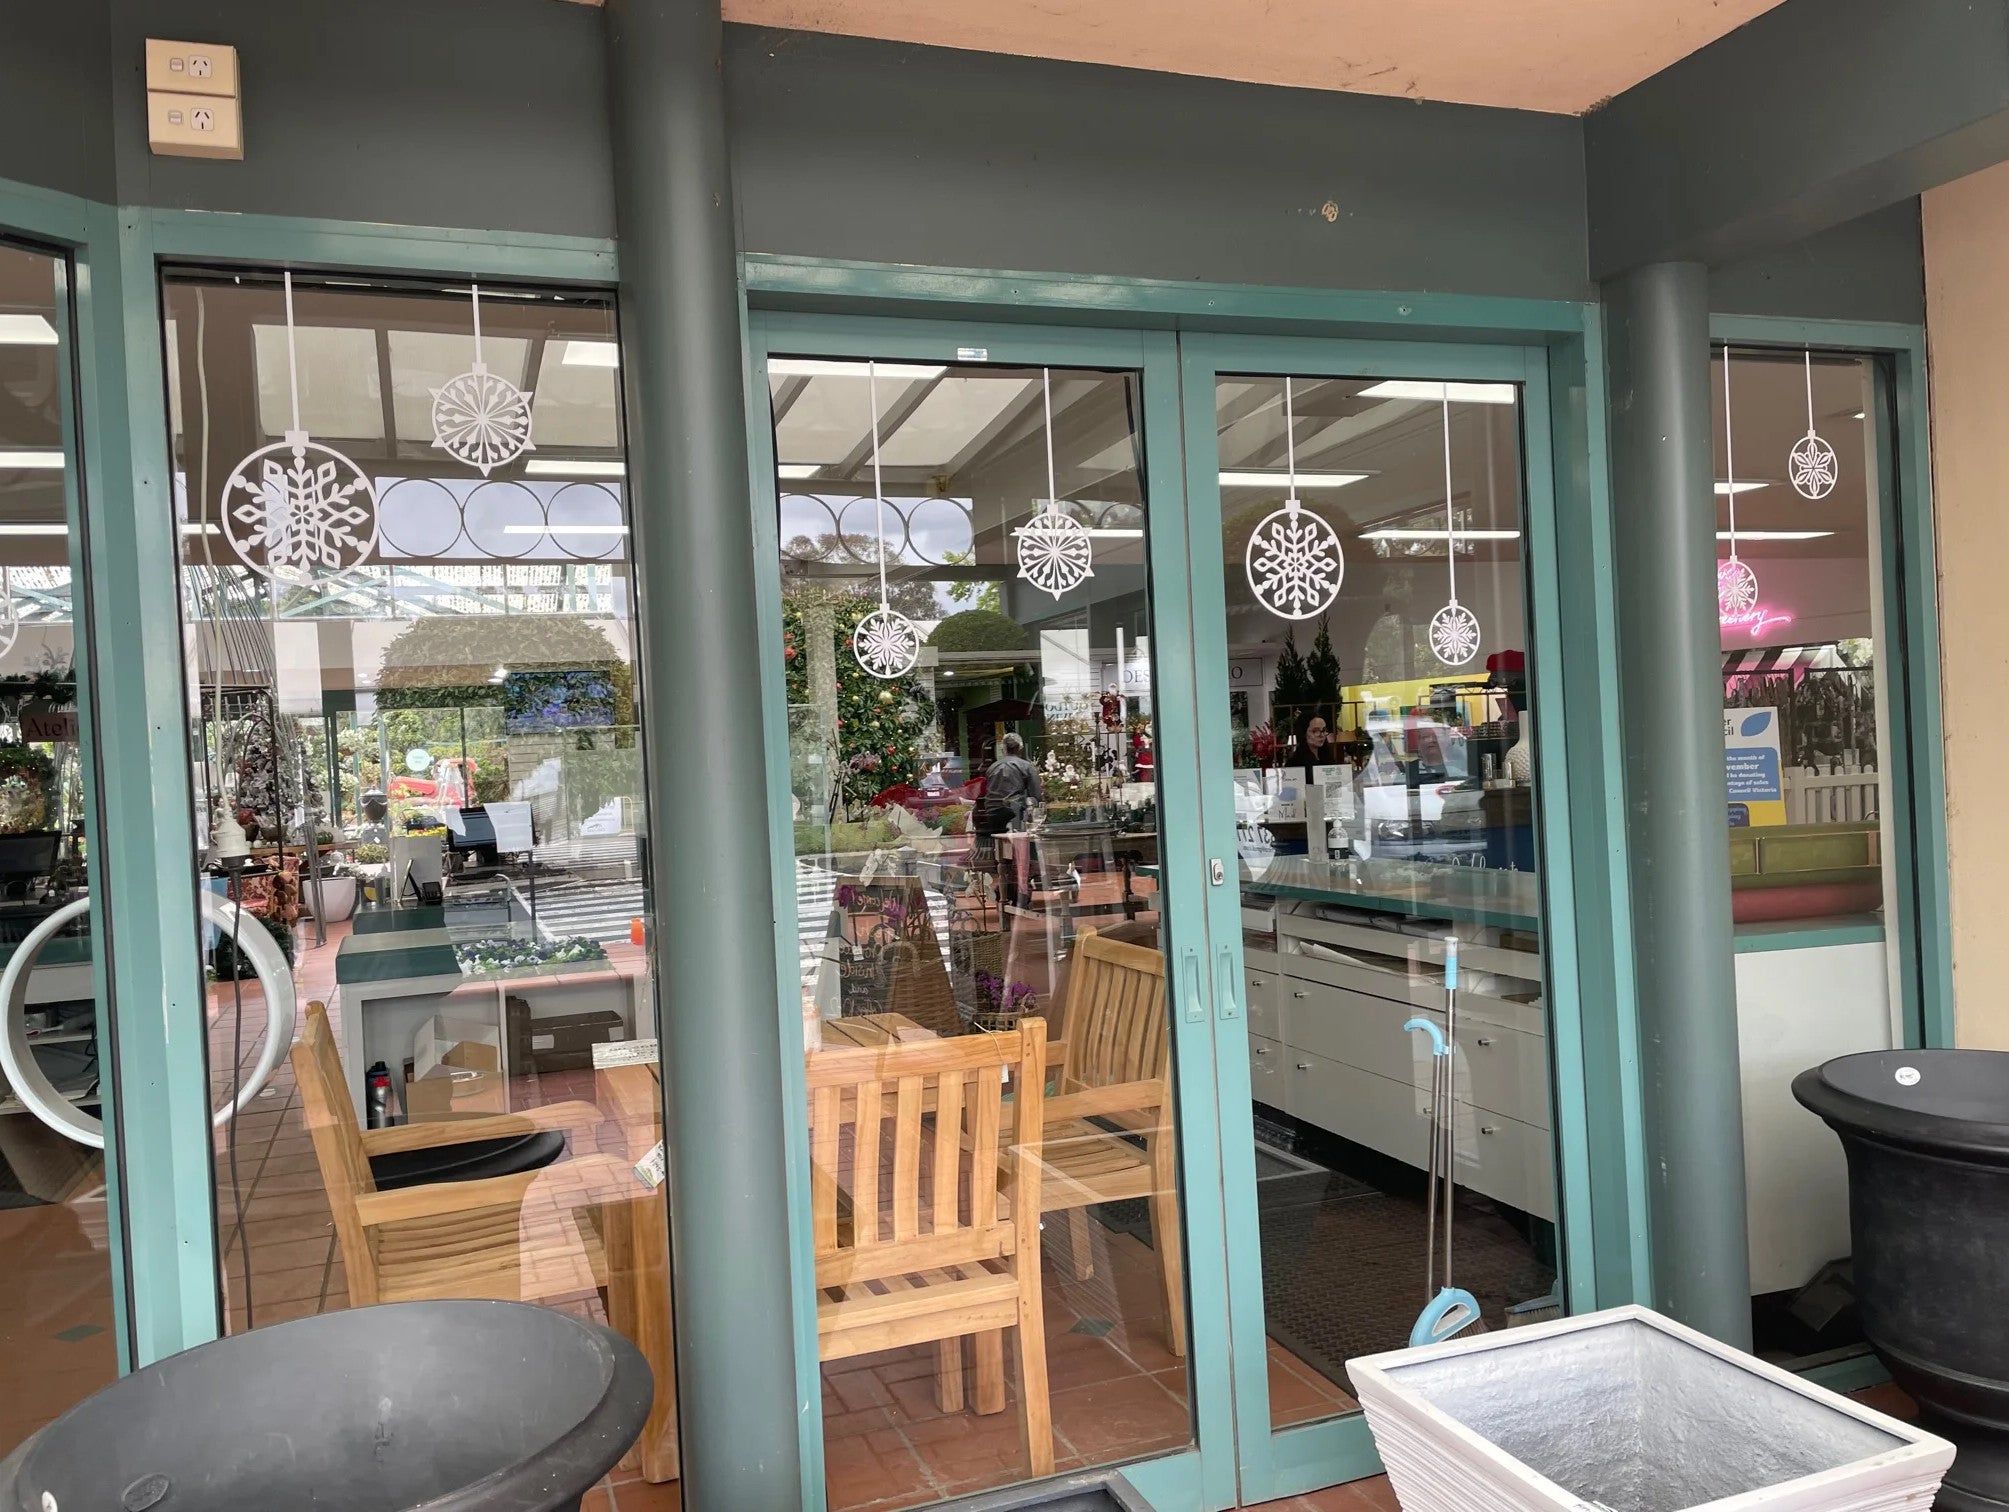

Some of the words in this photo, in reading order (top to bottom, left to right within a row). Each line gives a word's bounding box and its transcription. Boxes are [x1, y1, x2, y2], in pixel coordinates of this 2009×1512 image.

[1123, 669, 1150, 684] DES
[27, 717, 77, 737] Ateli
[1726, 762, 1760, 771] vember
